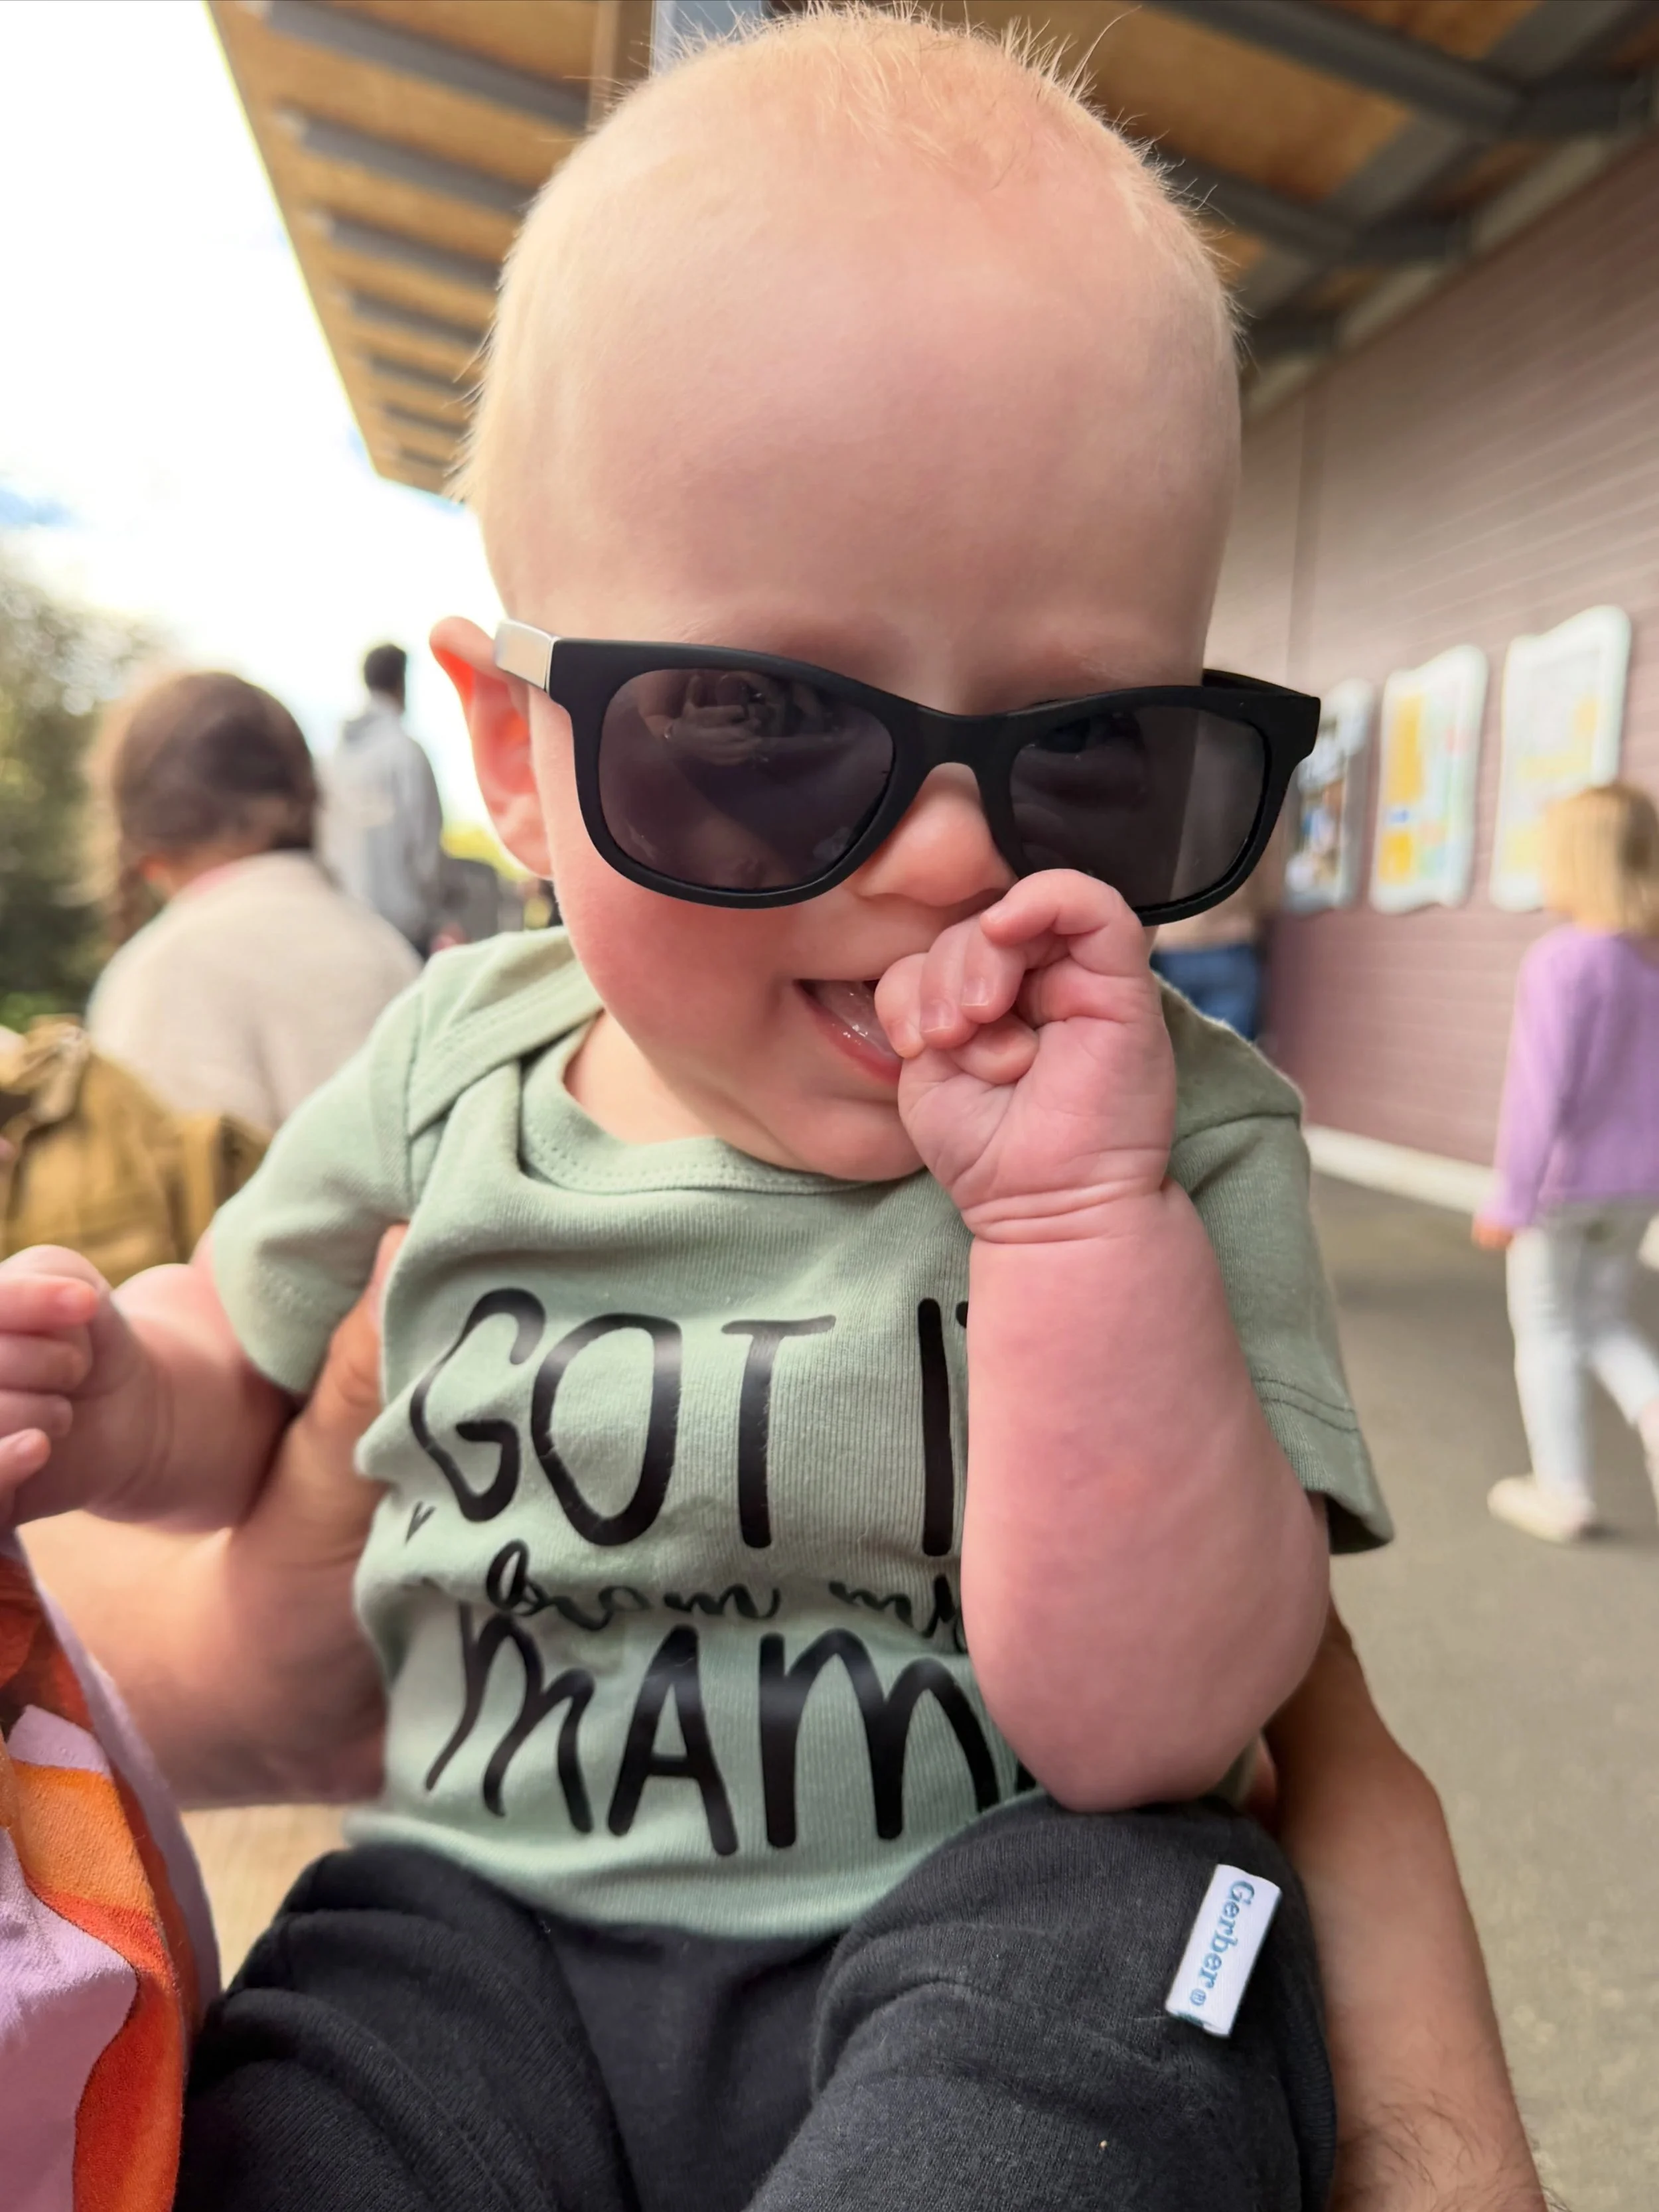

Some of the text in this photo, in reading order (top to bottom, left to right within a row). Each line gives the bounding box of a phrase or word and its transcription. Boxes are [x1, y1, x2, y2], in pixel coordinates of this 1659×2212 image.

[409, 1287, 969, 1557] GOT I
[426, 1602, 1037, 1857] MAM
